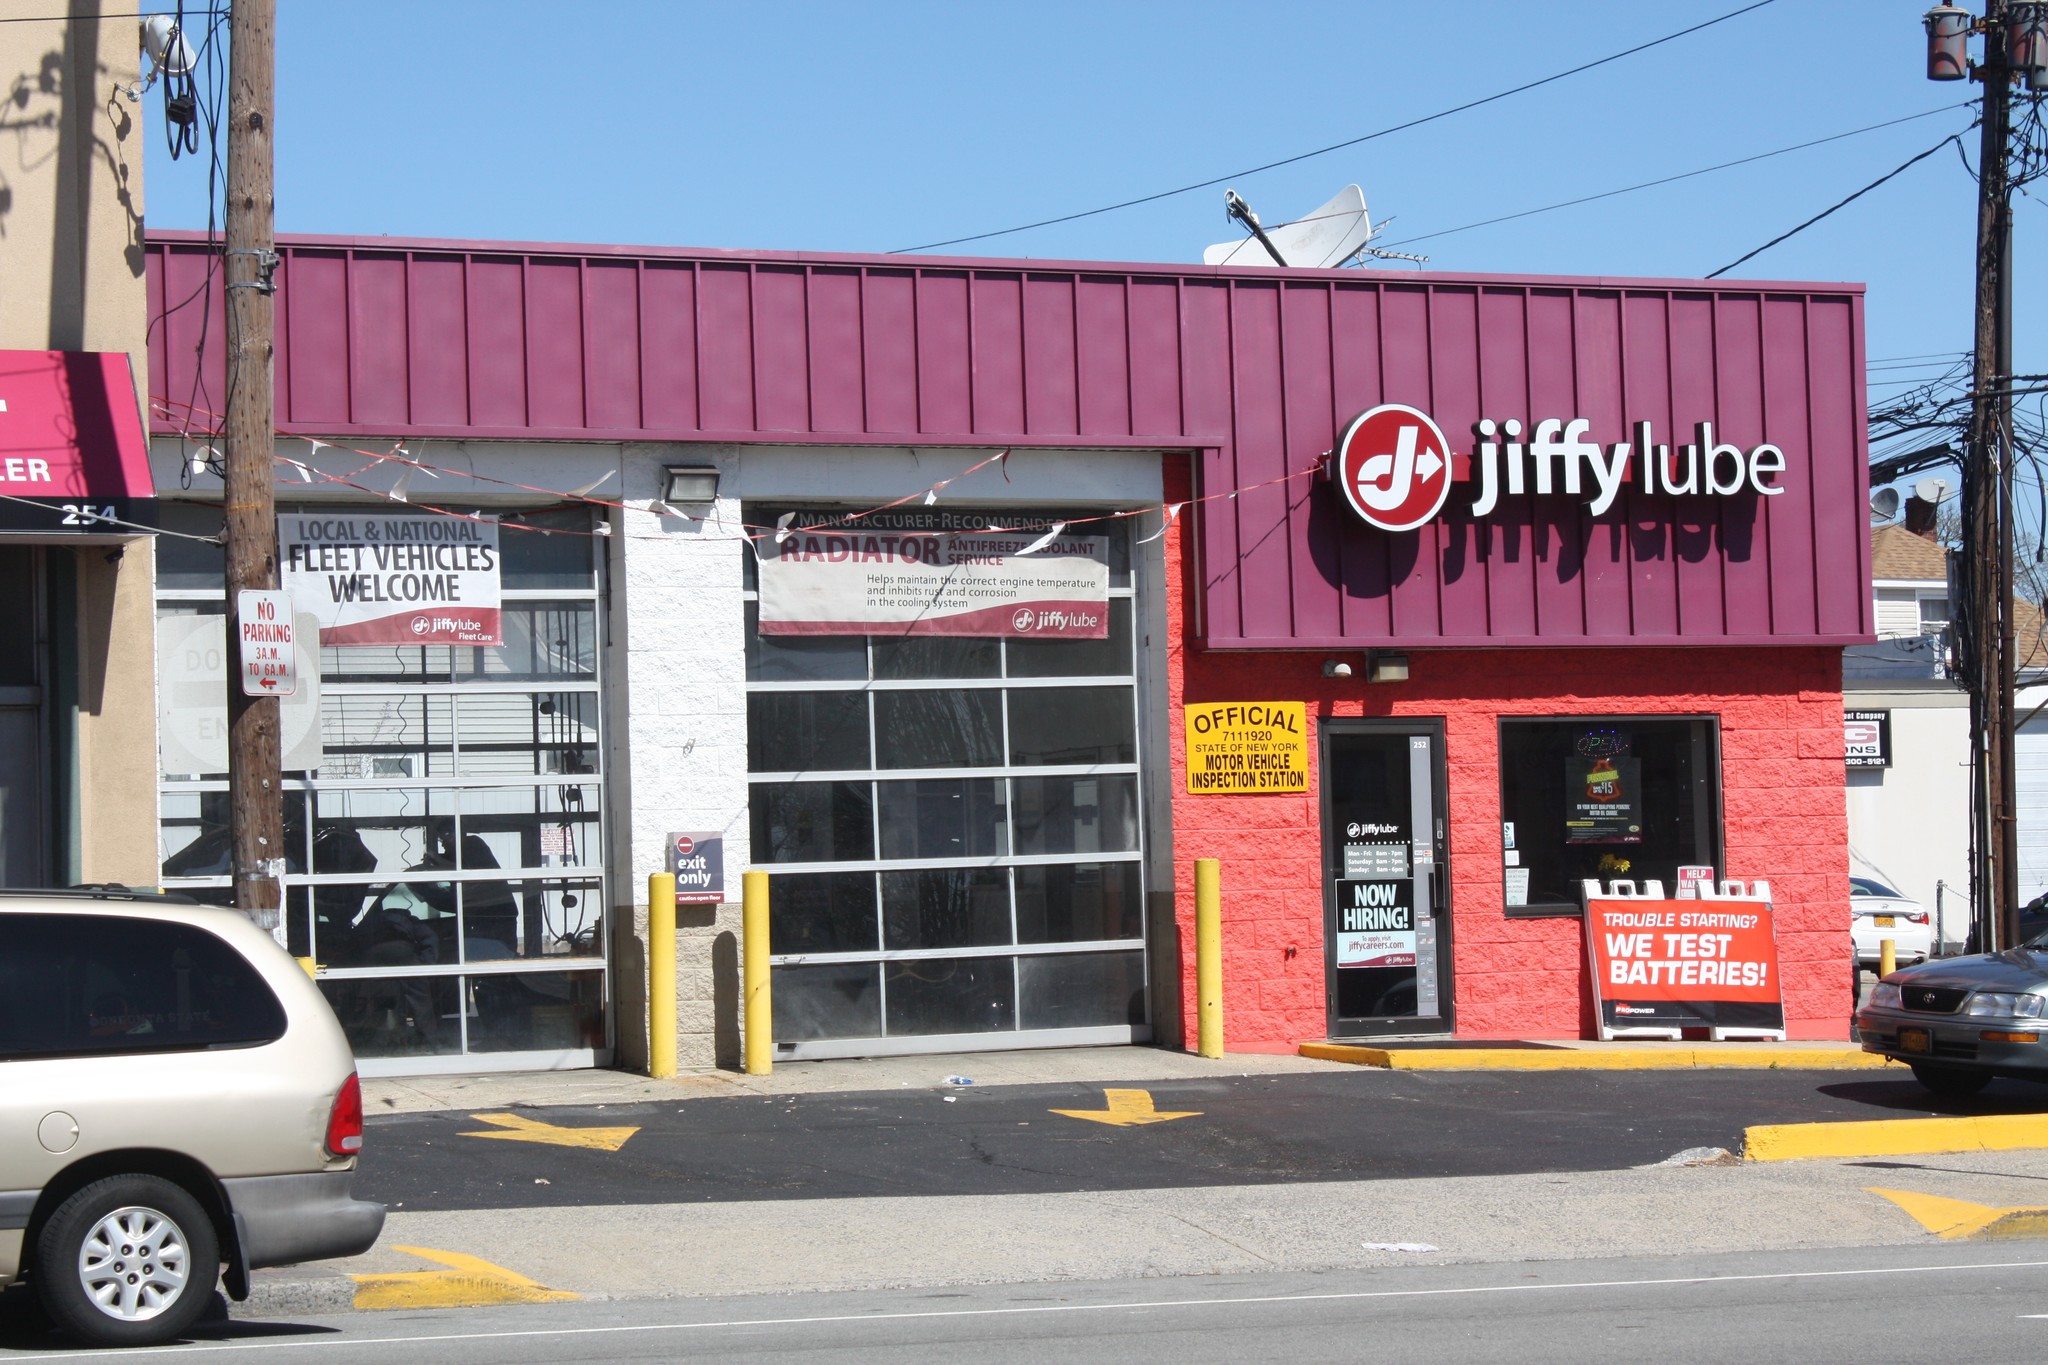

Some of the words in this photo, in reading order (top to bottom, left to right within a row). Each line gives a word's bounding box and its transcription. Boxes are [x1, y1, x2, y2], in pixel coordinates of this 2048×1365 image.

[0, 458, 51, 482] ER
[62, 504, 118, 525] 254
[299, 520, 360, 541] LOCAL
[365, 521, 380, 541] &
[385, 521, 483, 542] NATIONAL
[289, 544, 366, 572] FLEET
[372, 544, 494, 572] VEHICLES
[780, 536, 941, 564] RADIATOR
[948, 553, 1003, 566] SERVICE
[329, 574, 461, 603] WELCOME
[867, 574, 894, 587] Helps
[897, 575, 937, 585] maintain
[941, 575, 957, 585] the
[961, 577, 996, 586] correct
[1000, 579, 1033, 591] engine
[1037, 579, 1096, 591] temperature
[867, 586, 885, 595] and
[889, 586, 922, 595] inhibits
[925, 588, 944, 596] rust
[946, 587, 965, 597] and
[969, 588, 1016, 597] corrosion
[257, 602, 275, 620] NO
[867, 598, 876, 606] in
[879, 597, 894, 607] the
[898, 598, 930, 609] cooling
[933, 600, 968, 609] system
[243, 623, 291, 643] PARKING
[459, 633, 477, 641] Fleet
[478, 633, 492, 641] Care
[248, 663, 259, 676] TO
[1194, 706, 1298, 734] OFFICIAL
[1856, 712, 1885, 720] Company
[1222, 731, 1272, 741] 7111920
[1195, 744, 1227, 752] STATE
[1230, 743, 1243, 752] OF
[1247, 743, 1269, 752] NEW
[1272, 743, 1298, 751] YORK
[1206, 754, 1244, 770] MOTOR
[1247, 753, 1290, 770] VEHICLE
[1192, 772, 1256, 788] INSPECTION
[1260, 771, 1304, 787] STATION
[678, 855, 706, 870] exit
[678, 870, 711, 887] only
[1686, 869, 1706, 878] HELP
[1354, 884, 1397, 907] NOW
[1344, 907, 1409, 930] HIRING!
[1603, 913, 1675, 927] TROUBLE
[1680, 914, 1758, 928] STARTING?
[1349, 941, 1404, 952] jiffycareers.com
[1605, 933, 1653, 958] WE
[1663, 934, 1732, 958] TEST
[1610, 960, 1767, 986] BATTERIES!
